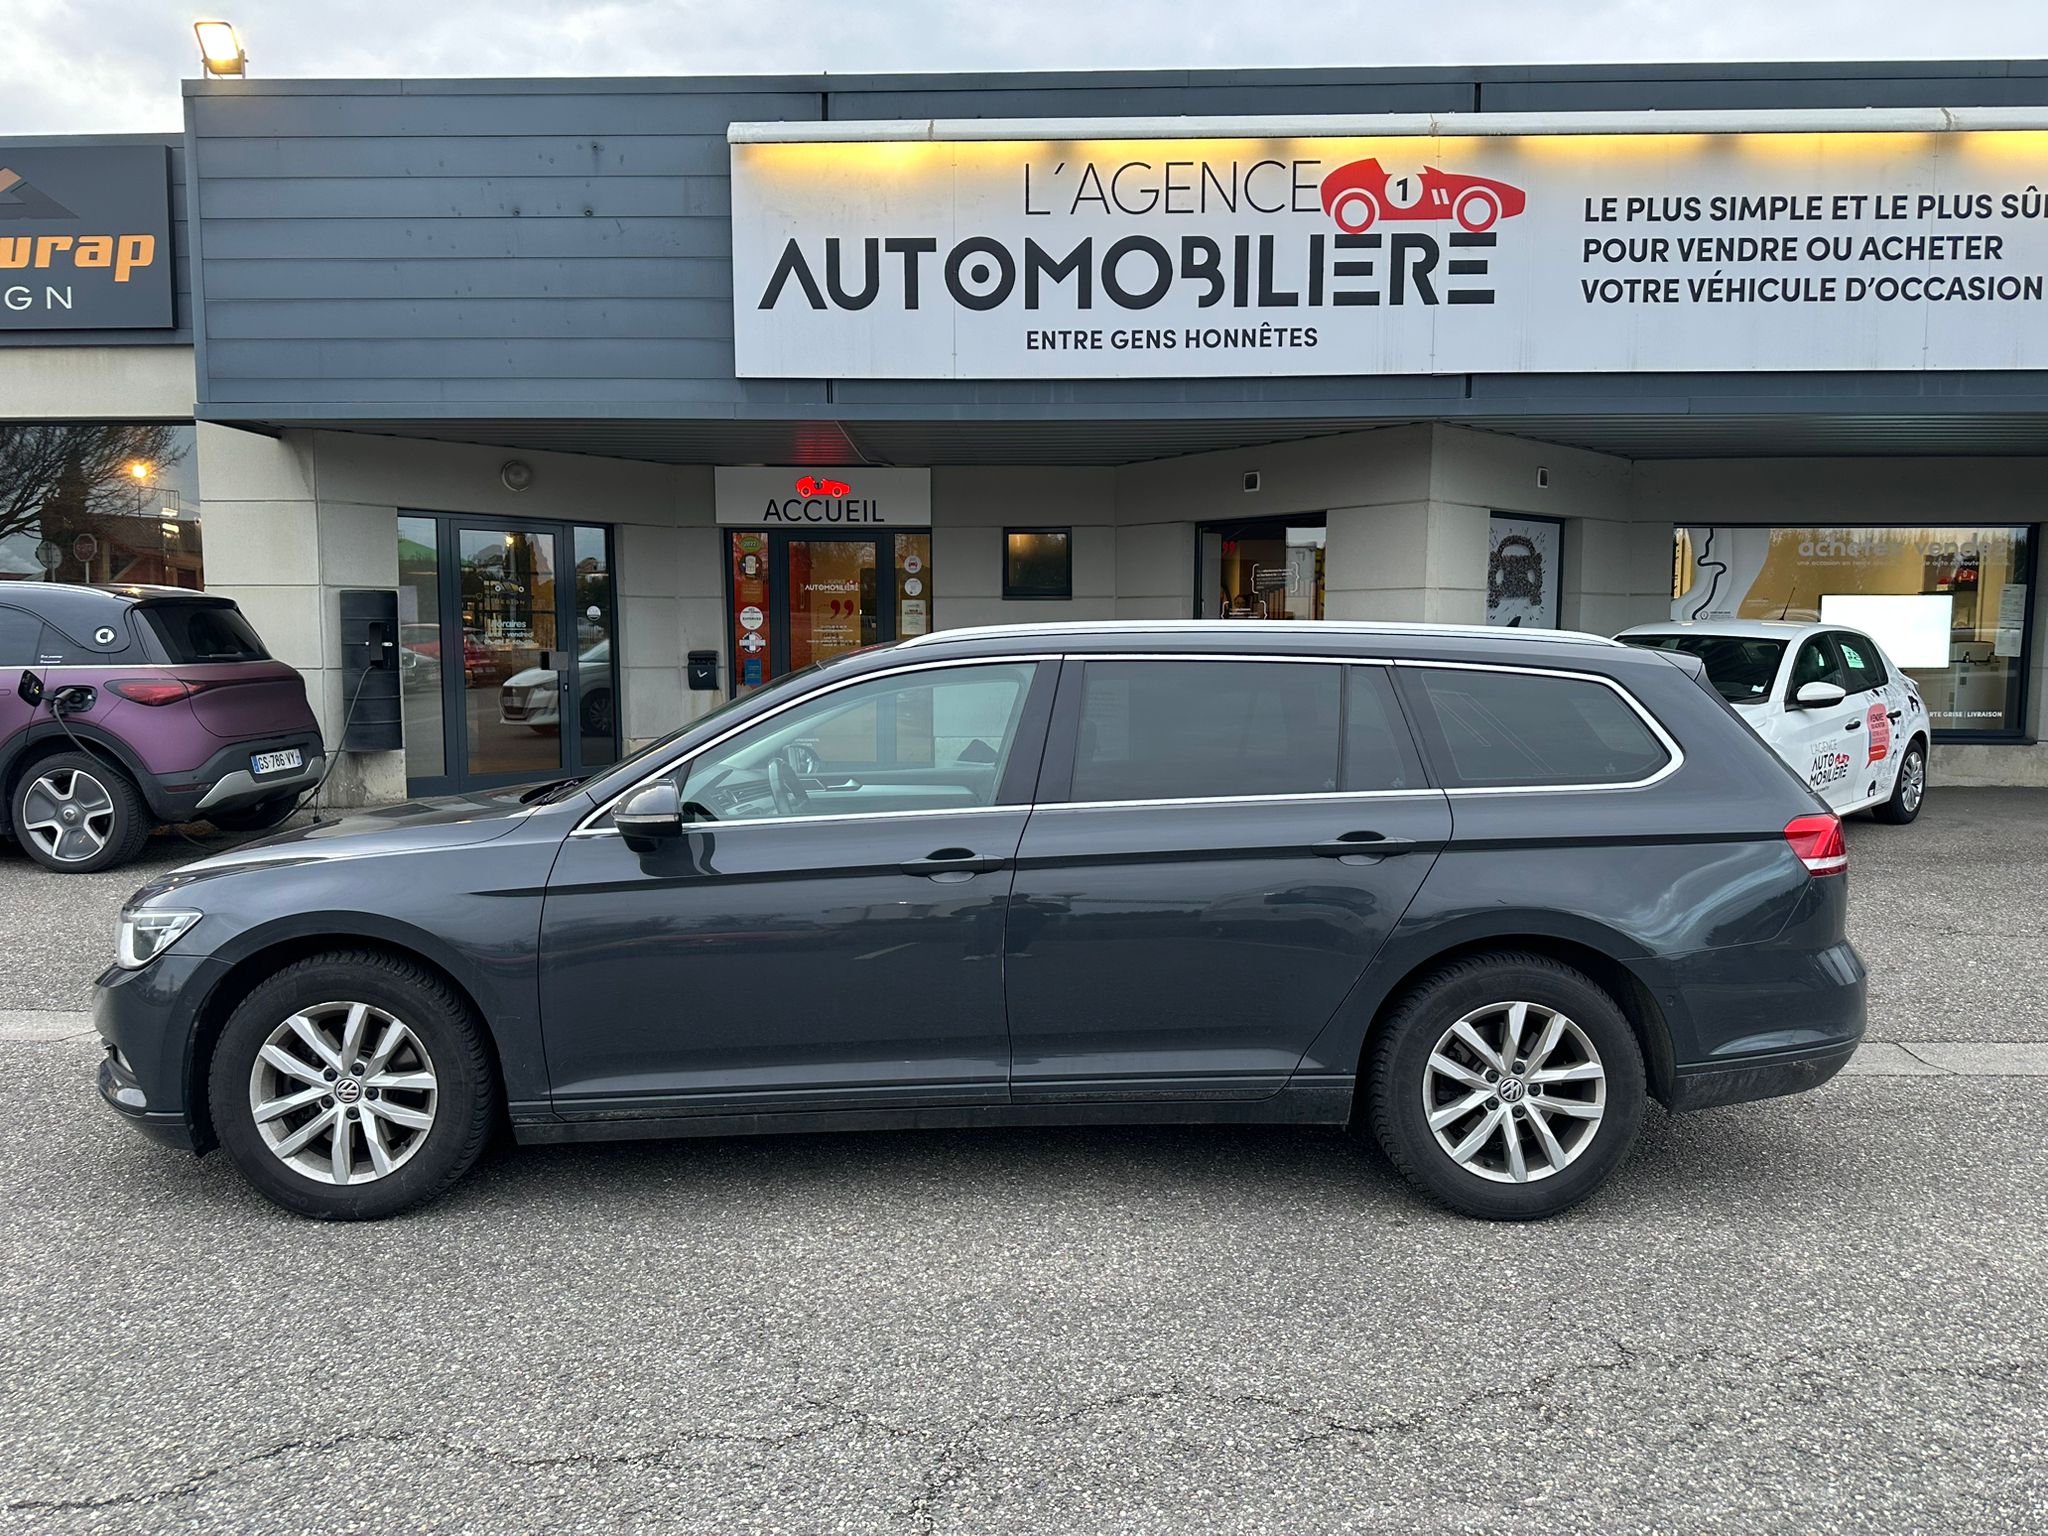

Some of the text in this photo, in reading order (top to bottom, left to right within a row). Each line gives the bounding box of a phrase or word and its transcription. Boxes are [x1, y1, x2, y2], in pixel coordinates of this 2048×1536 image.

[1024, 160, 1322, 215] L'AGENCE
[1584, 185, 2048, 222] LE PLUS SIMPLE ET LE PLUS SÛ
[1583, 235, 2004, 263] POUR VENDRE OU ACHETER
[1581, 269, 2043, 303] VOTRE VÉHICULE D'OCCASION
[1026, 321, 1318, 350] ENTRE GENS HONNÊTES
[763, 499, 885, 522] ACCUEIL
[1811, 752, 1835, 773] AUTO
